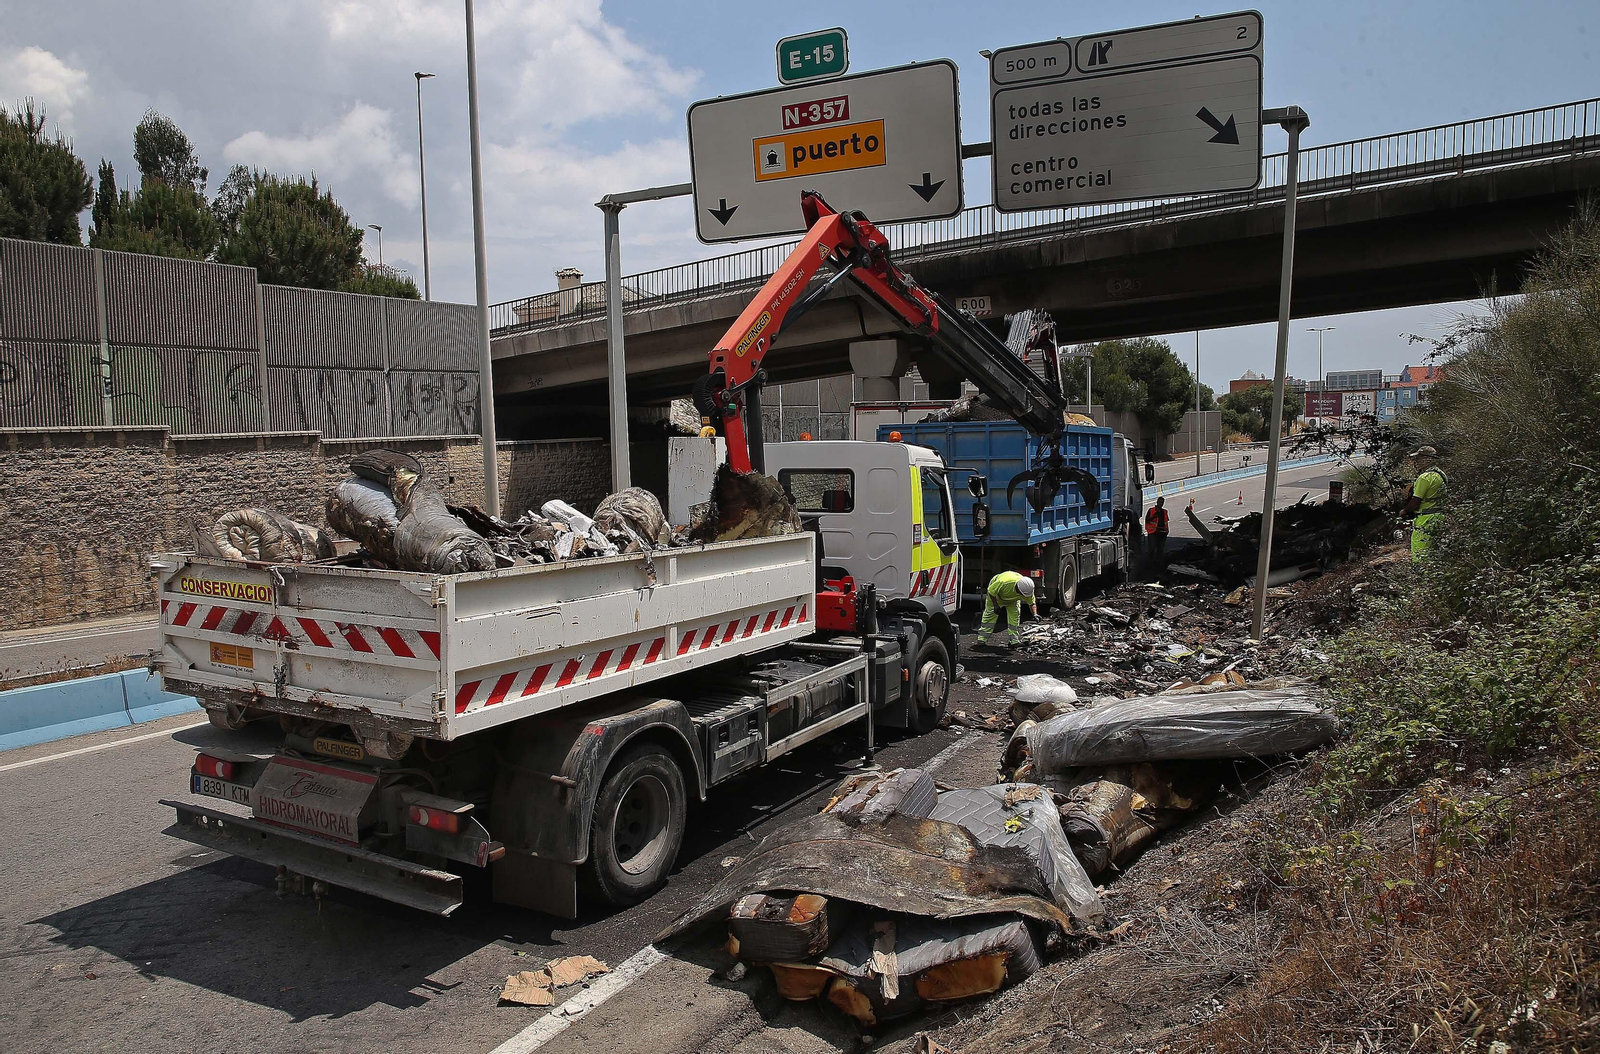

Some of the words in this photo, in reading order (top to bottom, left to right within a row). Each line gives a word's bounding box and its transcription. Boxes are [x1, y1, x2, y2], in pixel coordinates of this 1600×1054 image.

[1236, 26, 1248, 40] 2
[789, 44, 835, 69] E-15
[1006, 58, 1036, 73] 500
[1043, 55, 1057, 67] m
[784, 99, 847, 127] N-357
[1008, 100, 1064, 120] todas
[1072, 96, 1101, 112] las
[1009, 113, 1127, 141] direcciones
[792, 132, 879, 169] puerto
[1010, 156, 1078, 176] centro
[1010, 169, 1112, 195] comercial
[770, 299, 781, 311] PK
[737, 313, 770, 355] PALFINGER
[316, 741, 361, 757] PALFINGER
[203, 780, 226, 797] 8391
[231, 785, 250, 803] KTM
[259, 795, 353, 836] HIDROMAYORAL
